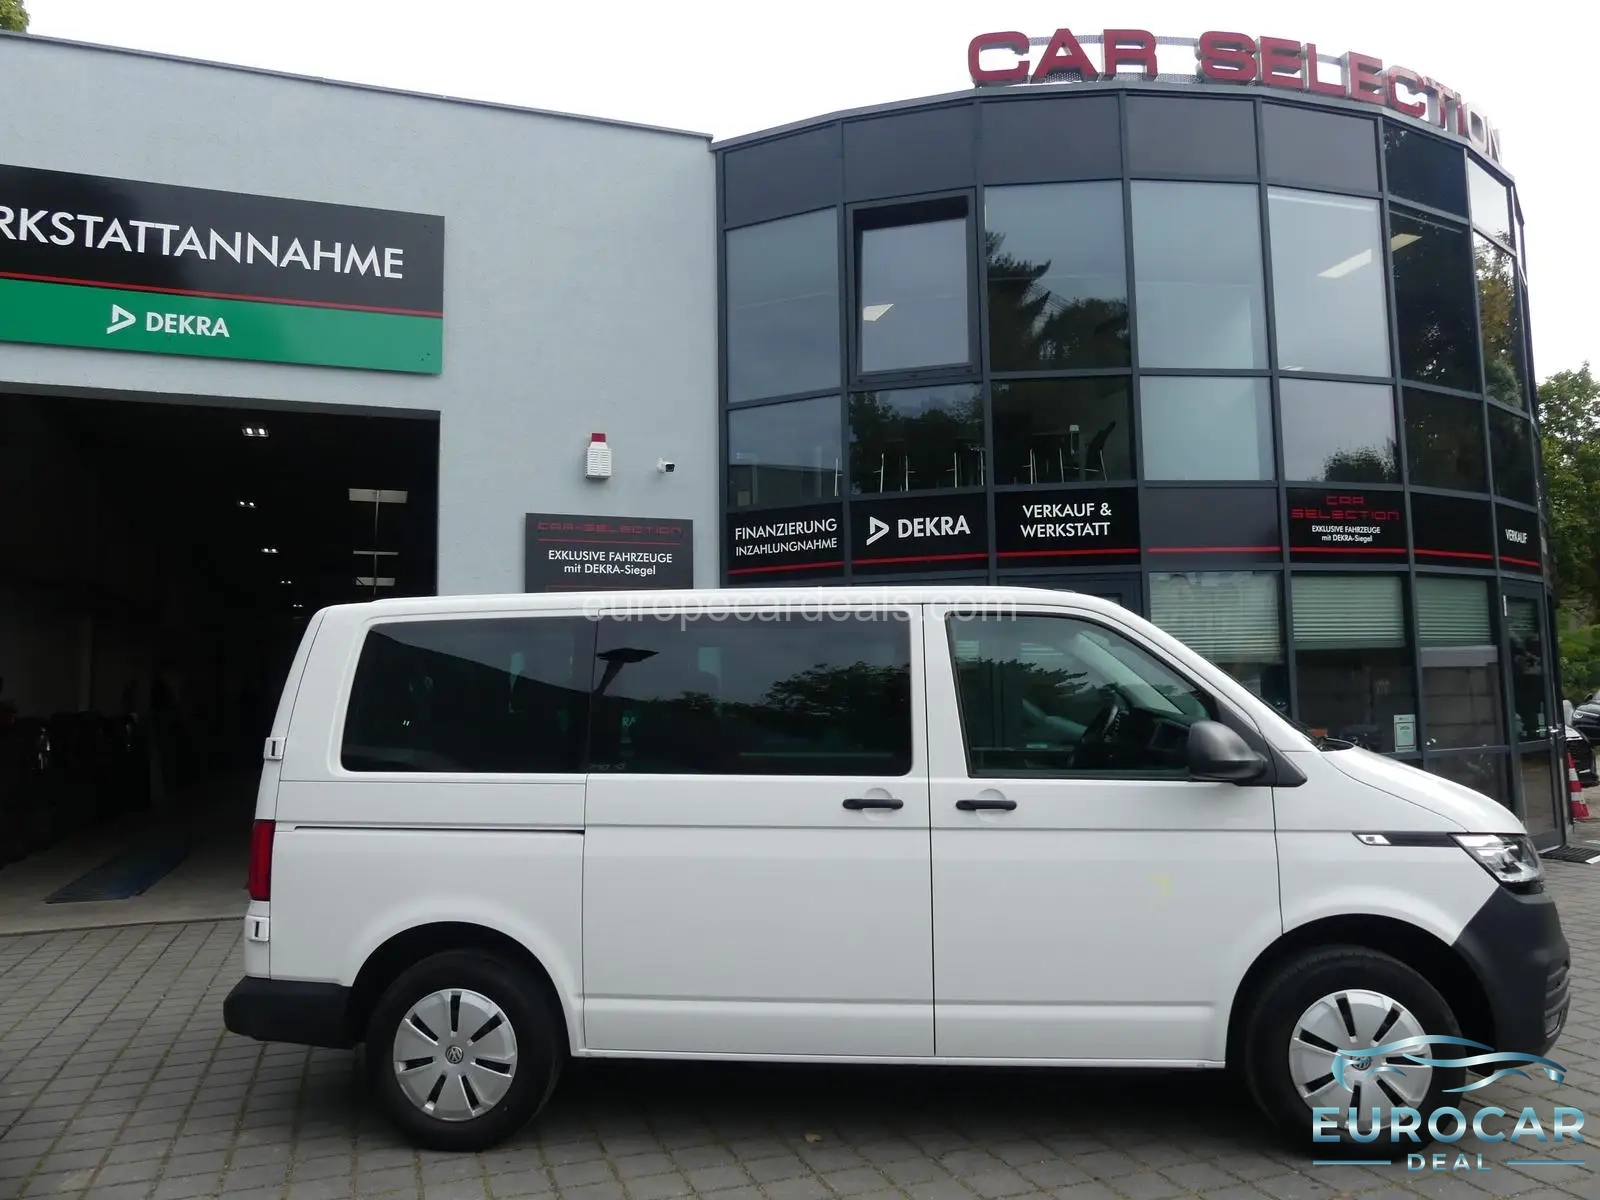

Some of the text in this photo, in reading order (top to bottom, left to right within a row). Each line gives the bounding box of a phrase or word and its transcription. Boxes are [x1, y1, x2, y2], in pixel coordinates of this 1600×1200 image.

[967, 28, 1502, 166] CAR SELECTION
[146, 311, 231, 338] DEKRA
[1022, 502, 1112, 519] VERKAUF &
[735, 518, 838, 541] FINANZIERUNG
[897, 515, 971, 539] DEKRA
[1020, 522, 1111, 538] WERKSTATT
[548, 549, 673, 563] EXKLUSIVE FAHRZEUGE
[735, 537, 838, 557] INZAHLUNGNAHME
[563, 562, 657, 578] mit DEKRA-Siegel
